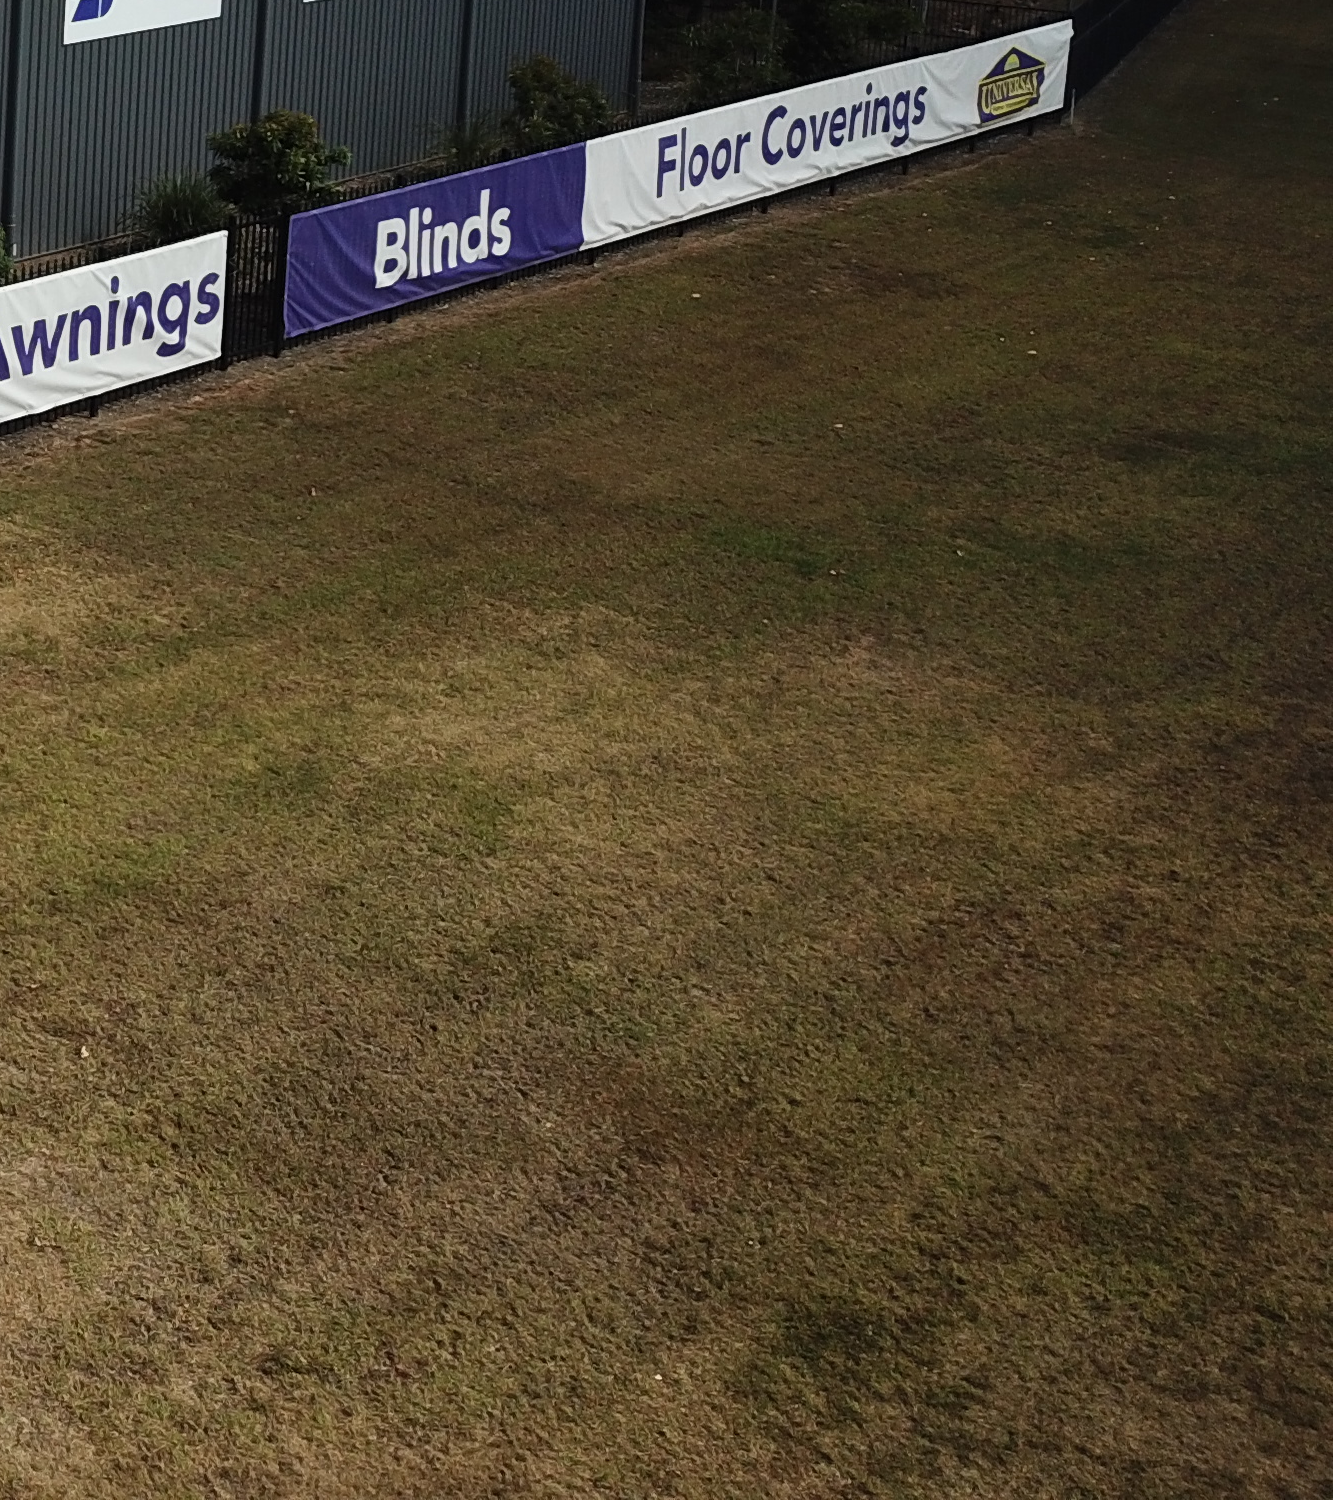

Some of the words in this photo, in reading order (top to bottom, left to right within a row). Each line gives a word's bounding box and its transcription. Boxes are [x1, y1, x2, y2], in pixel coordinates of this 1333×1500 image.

[656, 128, 752, 199] Floor
[760, 82, 927, 167] Coverings
[374, 188, 512, 290] Blinds
